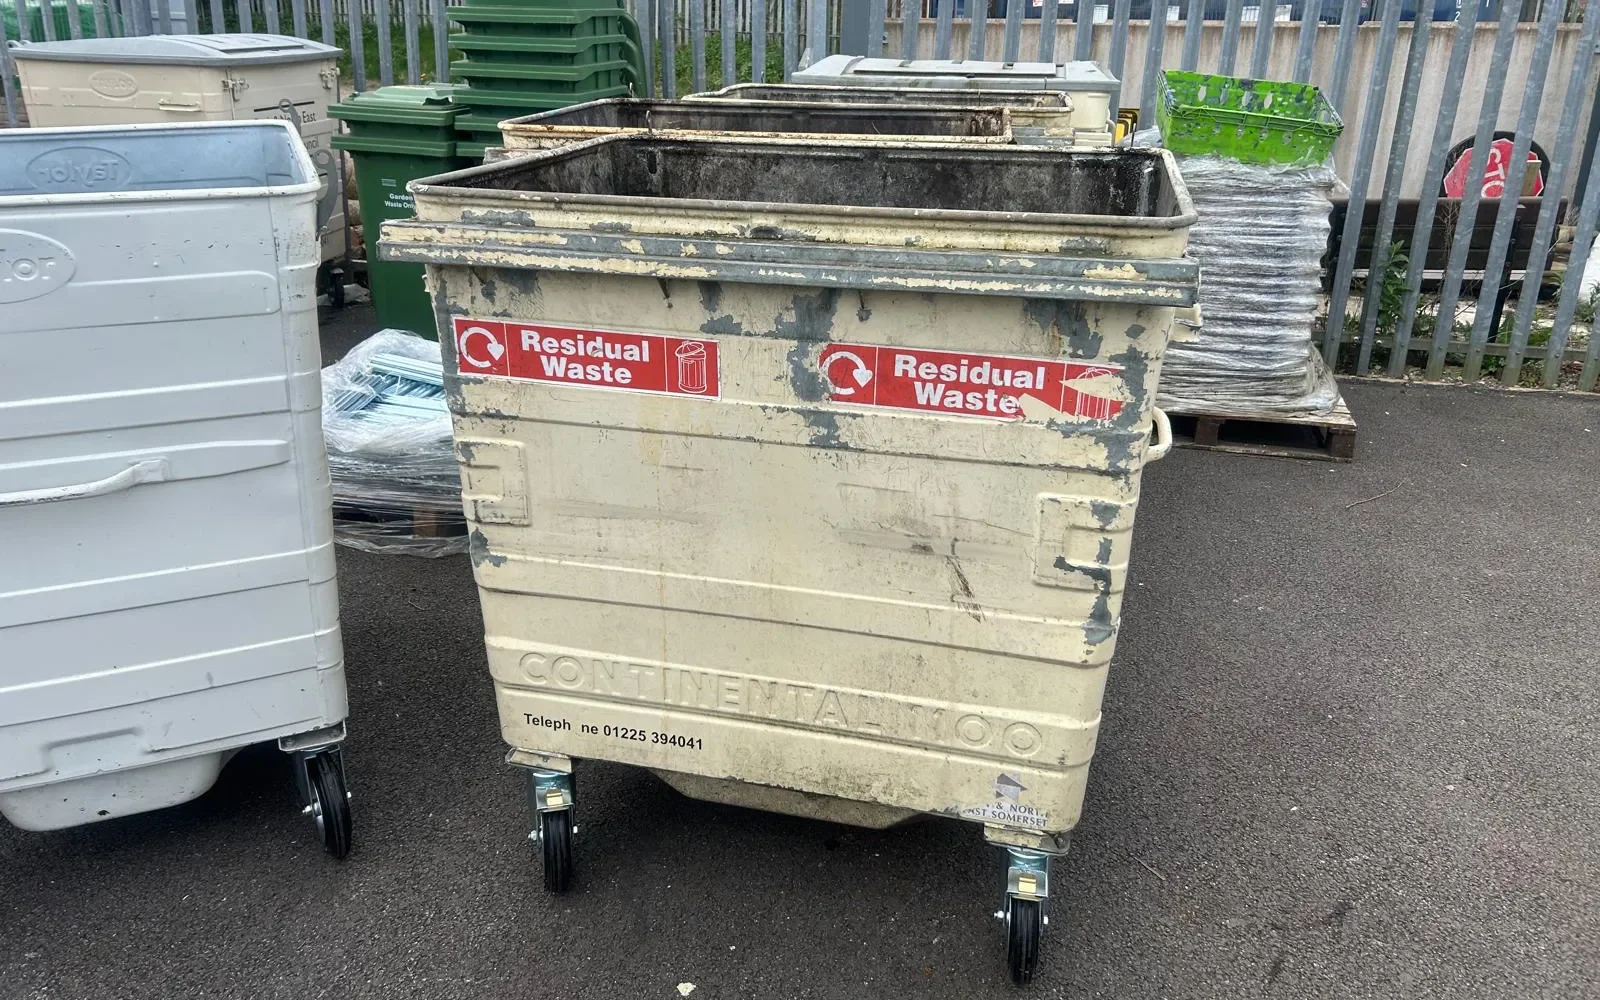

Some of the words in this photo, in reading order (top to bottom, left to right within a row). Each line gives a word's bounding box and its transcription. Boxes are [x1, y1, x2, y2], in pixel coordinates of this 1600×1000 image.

[302, 111, 317, 124] East
[1481, 148, 1506, 198] STO
[520, 329, 650, 363] Residual
[540, 355, 633, 385] Waste
[893, 353, 1046, 390] Residual
[913, 381, 1020, 415] Waste
[518, 652, 881, 736] CONTINENTAL
[523, 712, 599, 735] Telephne
[603, 724, 647, 742] 01225
[651, 731, 703, 750] 394041
[991, 810, 1049, 828] SOMERSET
[995, 801, 1004, 811] &
